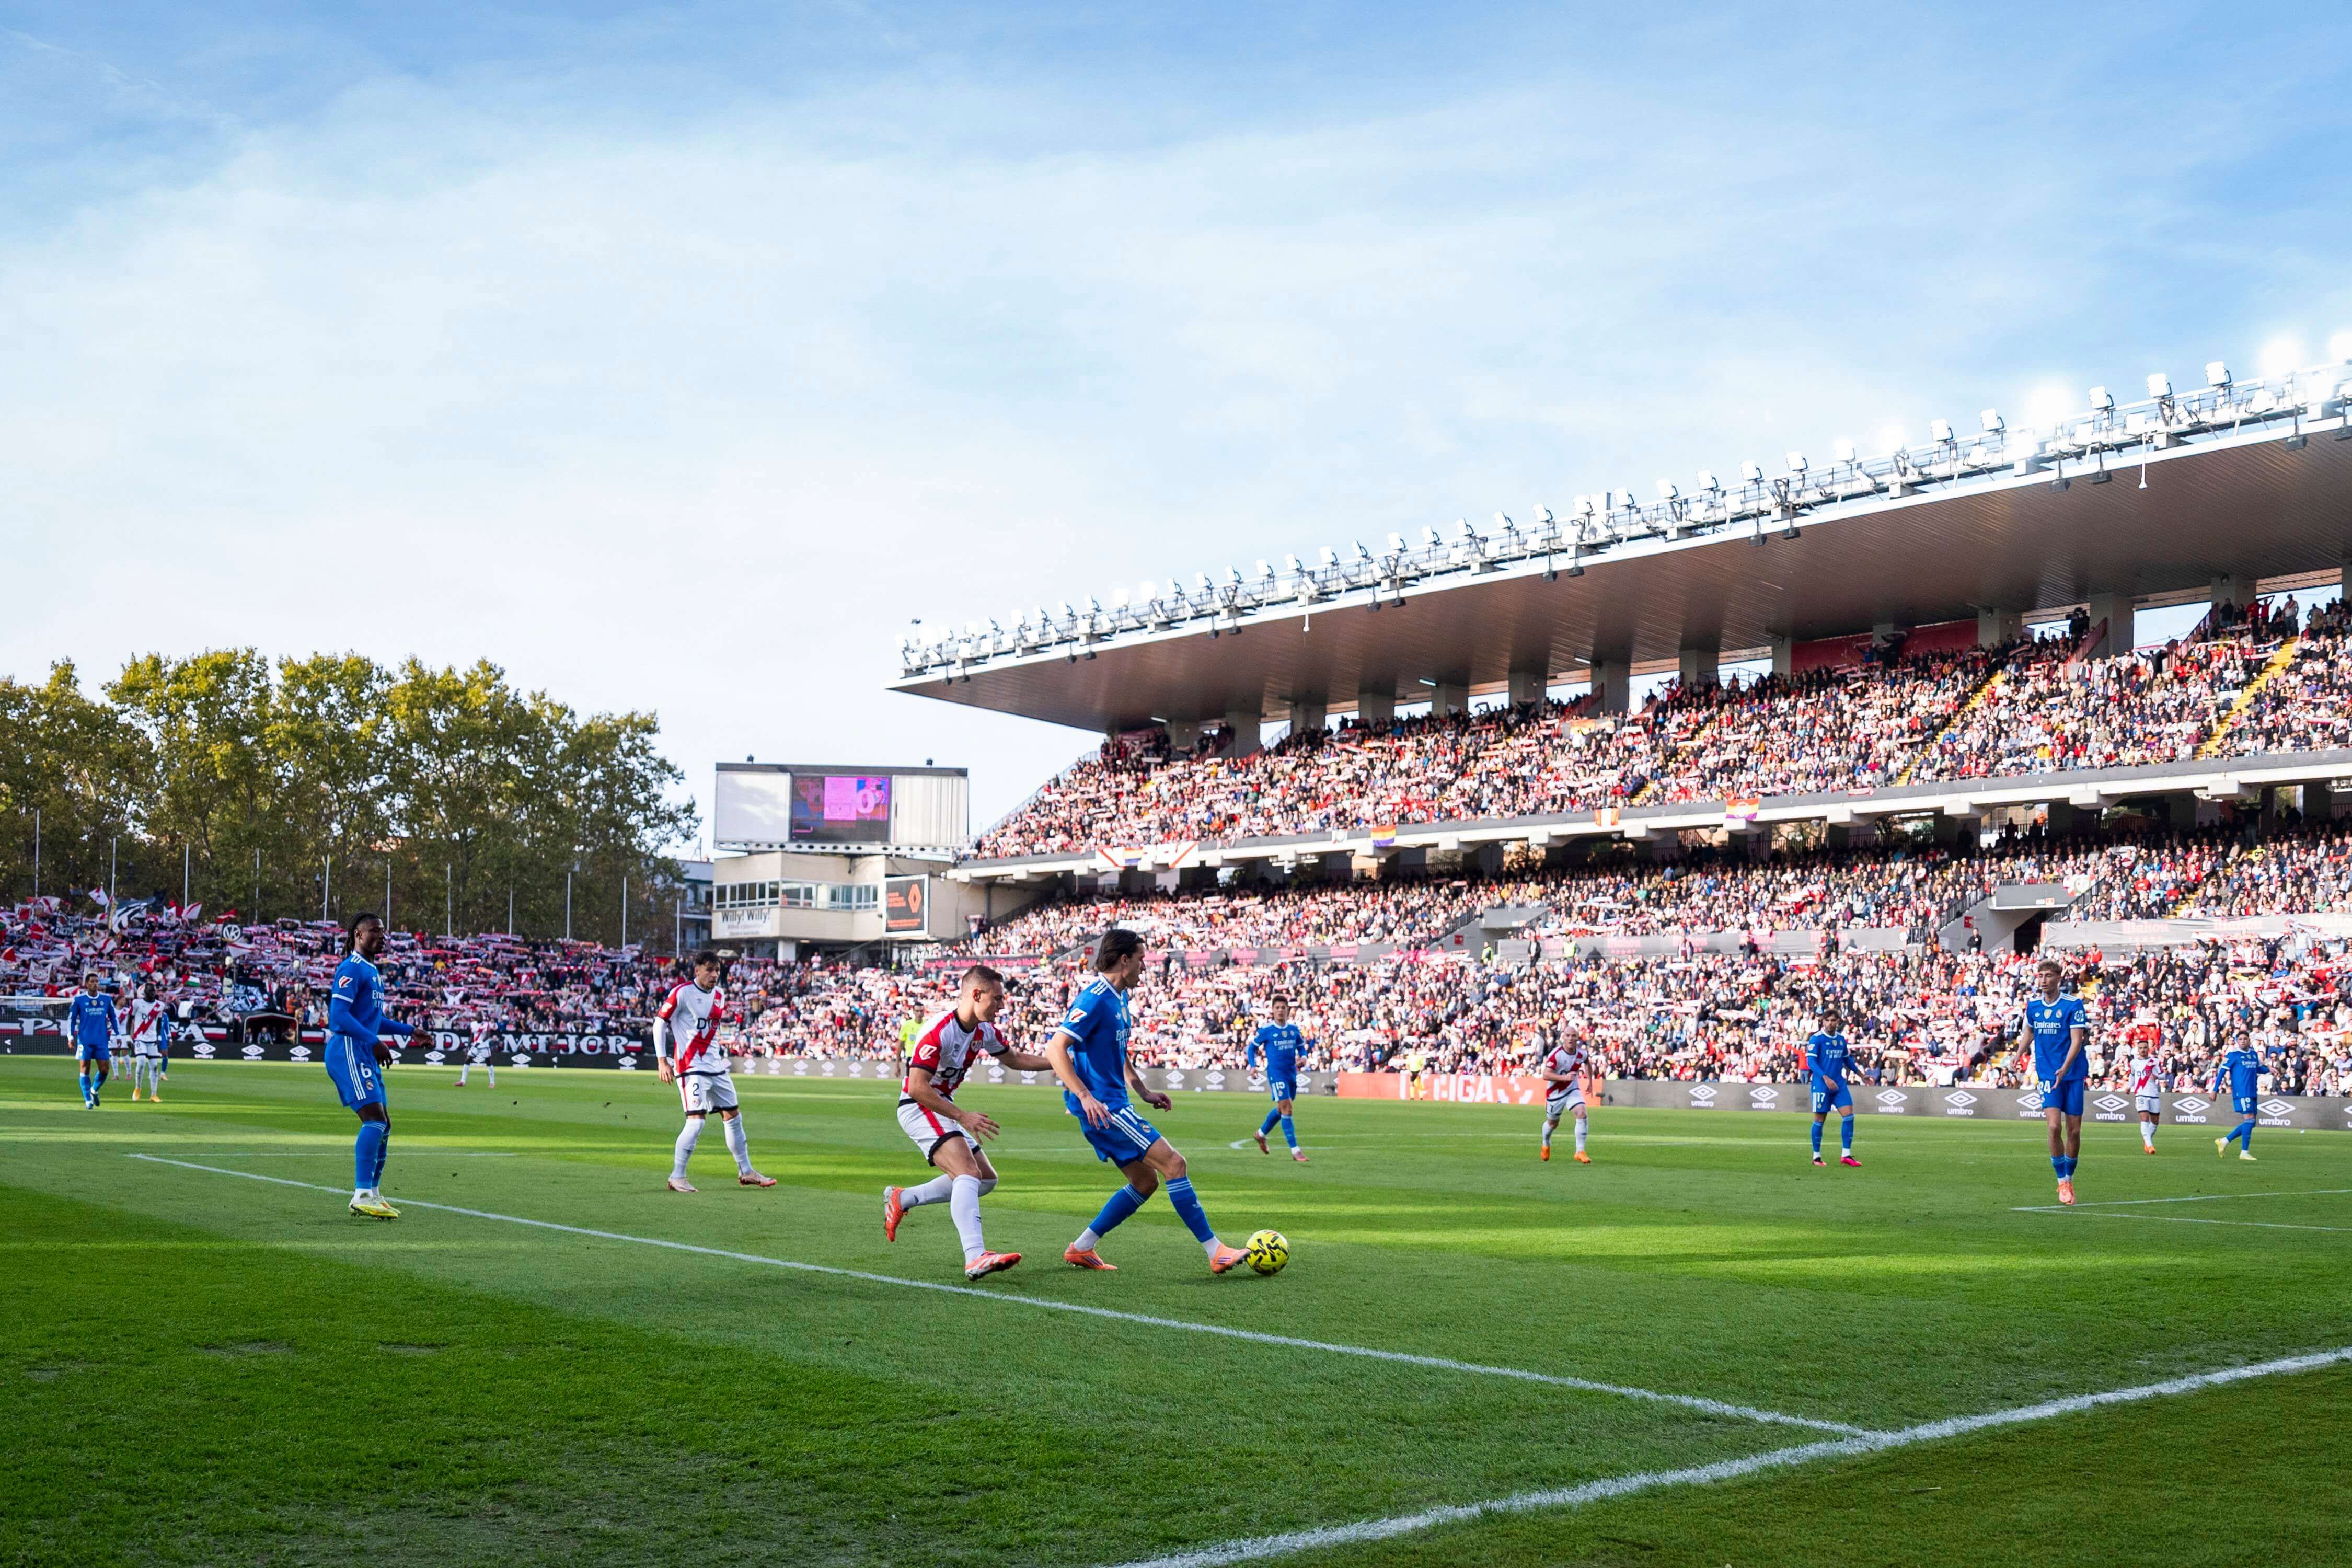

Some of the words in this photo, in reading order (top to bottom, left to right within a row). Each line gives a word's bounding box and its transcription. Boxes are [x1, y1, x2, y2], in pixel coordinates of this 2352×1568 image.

[360, 1062, 372, 1078] 6
[693, 1083, 699, 1096] 2
[2096, 1112, 2126, 1121] umbro
[2176, 1114, 2207, 1123] umbro
[2258, 1117, 2291, 1126] umbro
